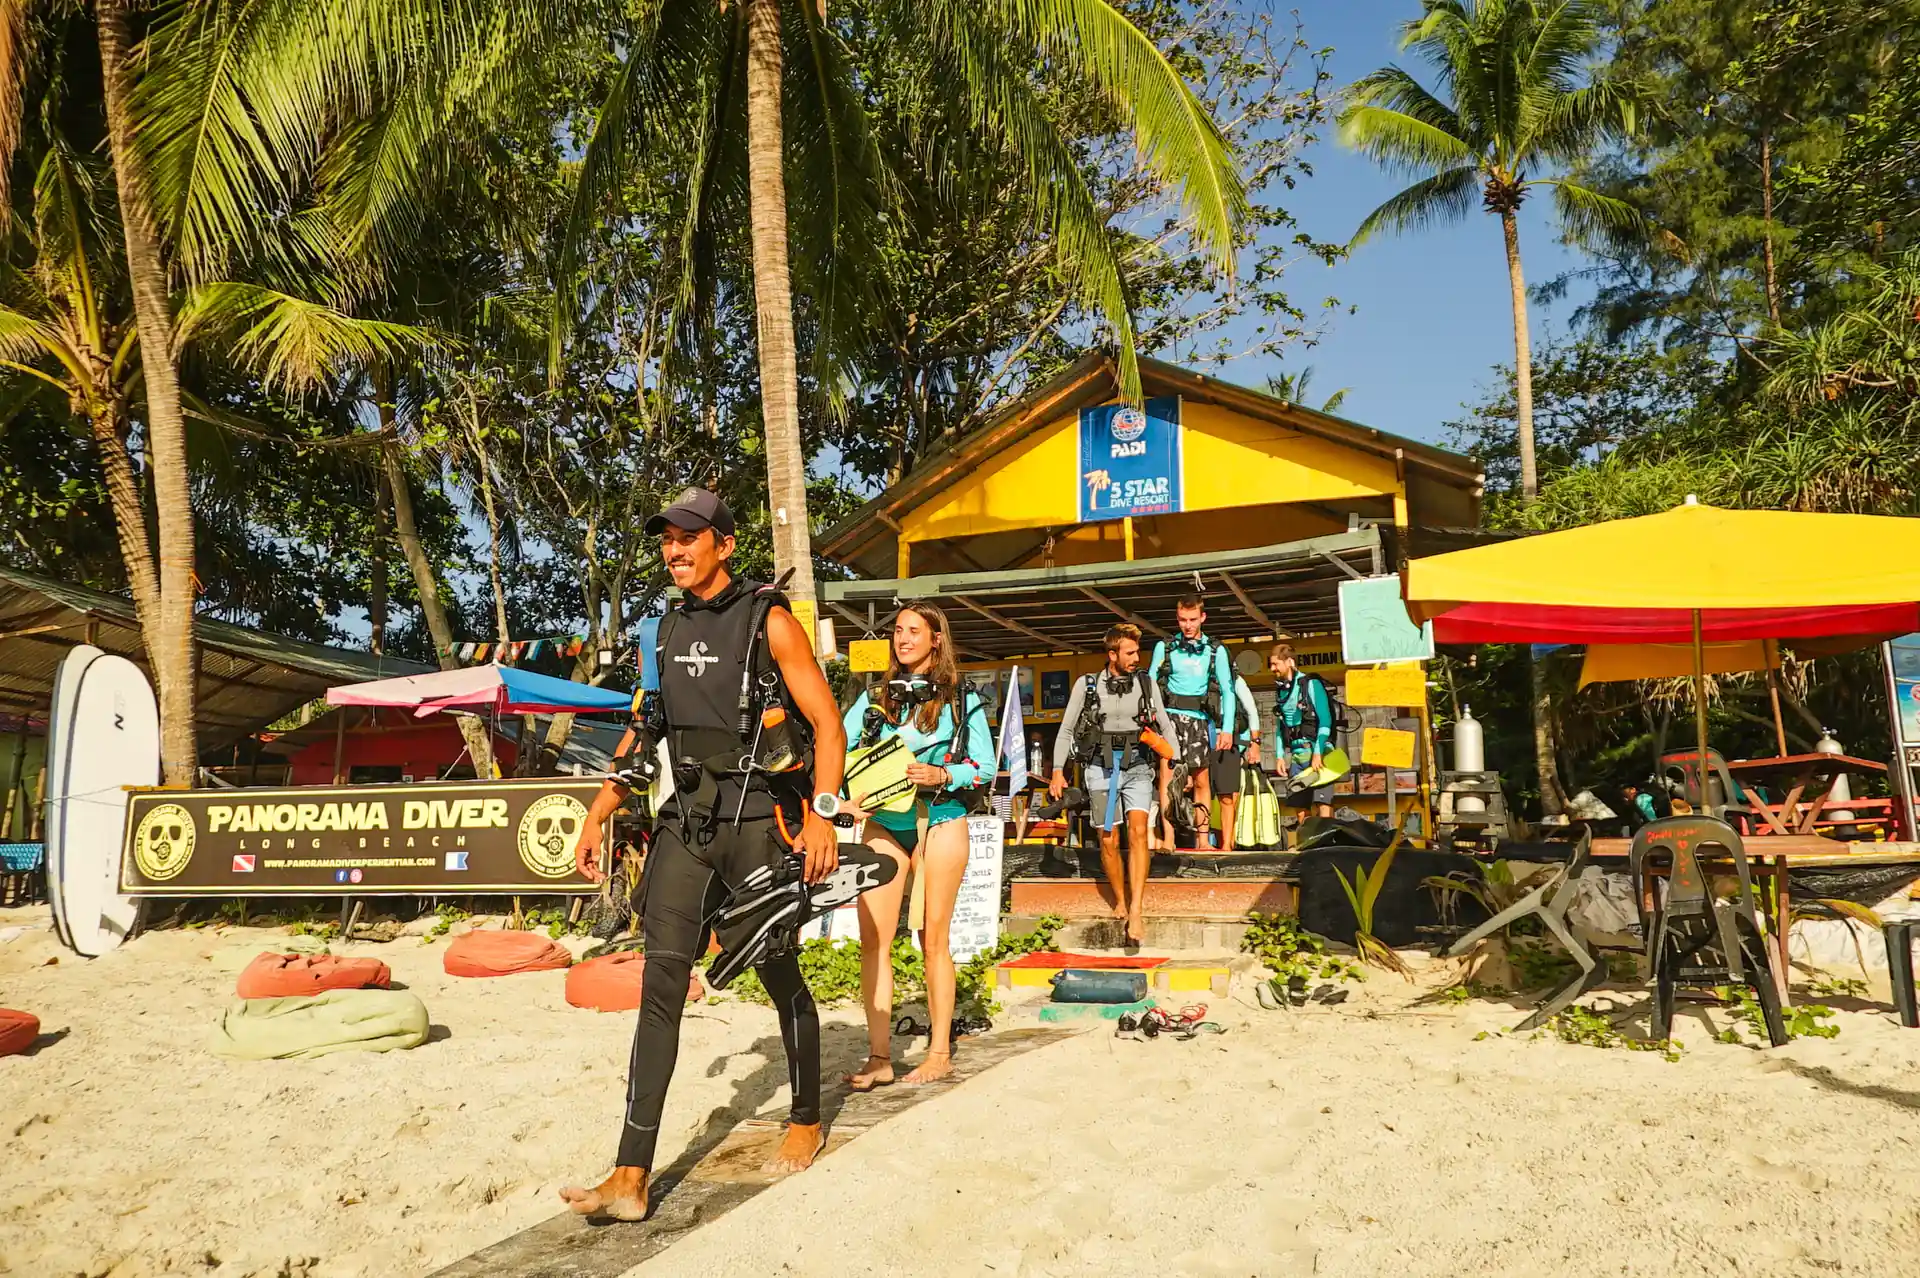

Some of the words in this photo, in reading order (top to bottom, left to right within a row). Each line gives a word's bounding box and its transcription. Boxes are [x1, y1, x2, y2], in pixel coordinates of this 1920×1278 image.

[1111, 441, 1146, 458] PADI
[1110, 481, 1122, 499] 5
[1124, 476, 1169, 498] STAR
[1110, 498, 1132, 509] DIVE
[1133, 493, 1169, 507] RESORT
[1297, 652, 1338, 666] ENTIAN
[207, 802, 390, 832] PANORAMA
[402, 798, 509, 830] DIVER
[967, 819, 998, 830] VER
[239, 838, 321, 850] LONG
[359, 835, 466, 848] BEACH
[968, 833, 998, 843] ATER
